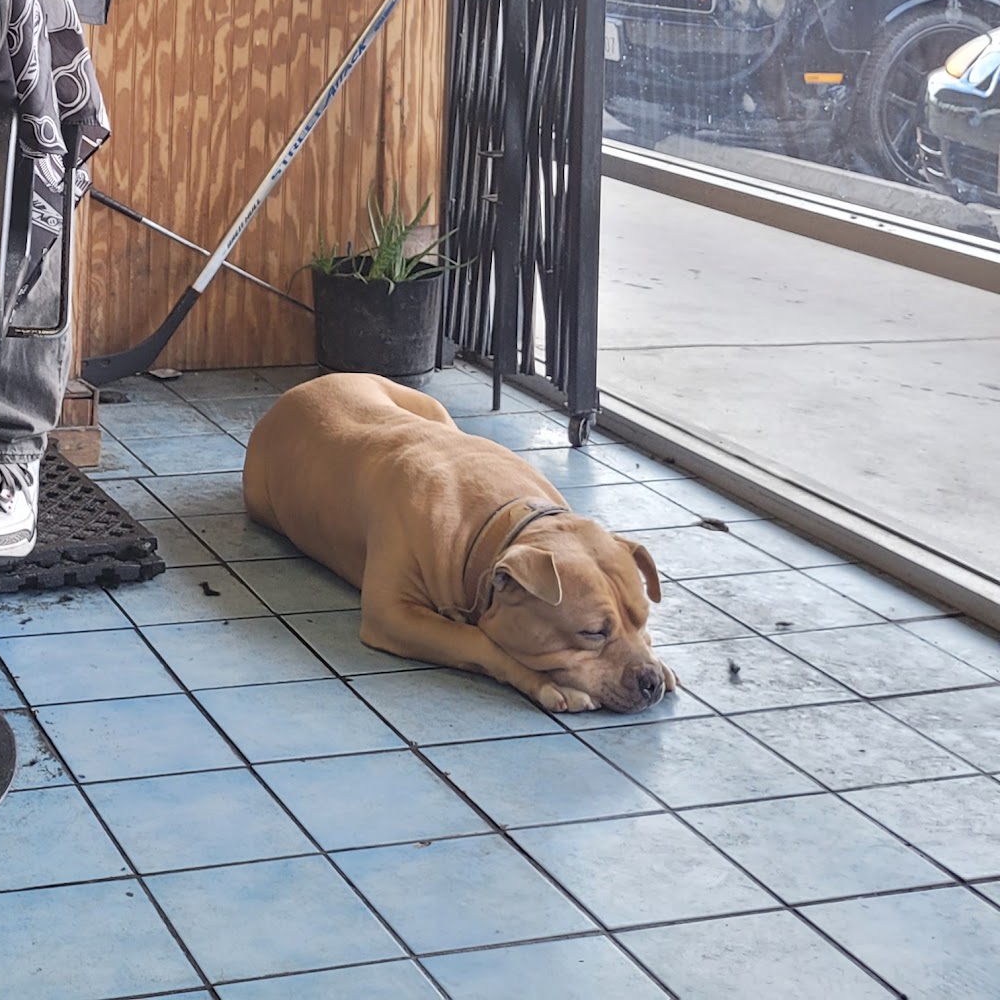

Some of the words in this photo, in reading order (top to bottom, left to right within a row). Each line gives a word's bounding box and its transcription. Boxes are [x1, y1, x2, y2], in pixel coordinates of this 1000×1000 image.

[271, 110, 321, 181] STREET
[322, 37, 367, 109] ATTACK
[245, 199, 261, 224] HULL
